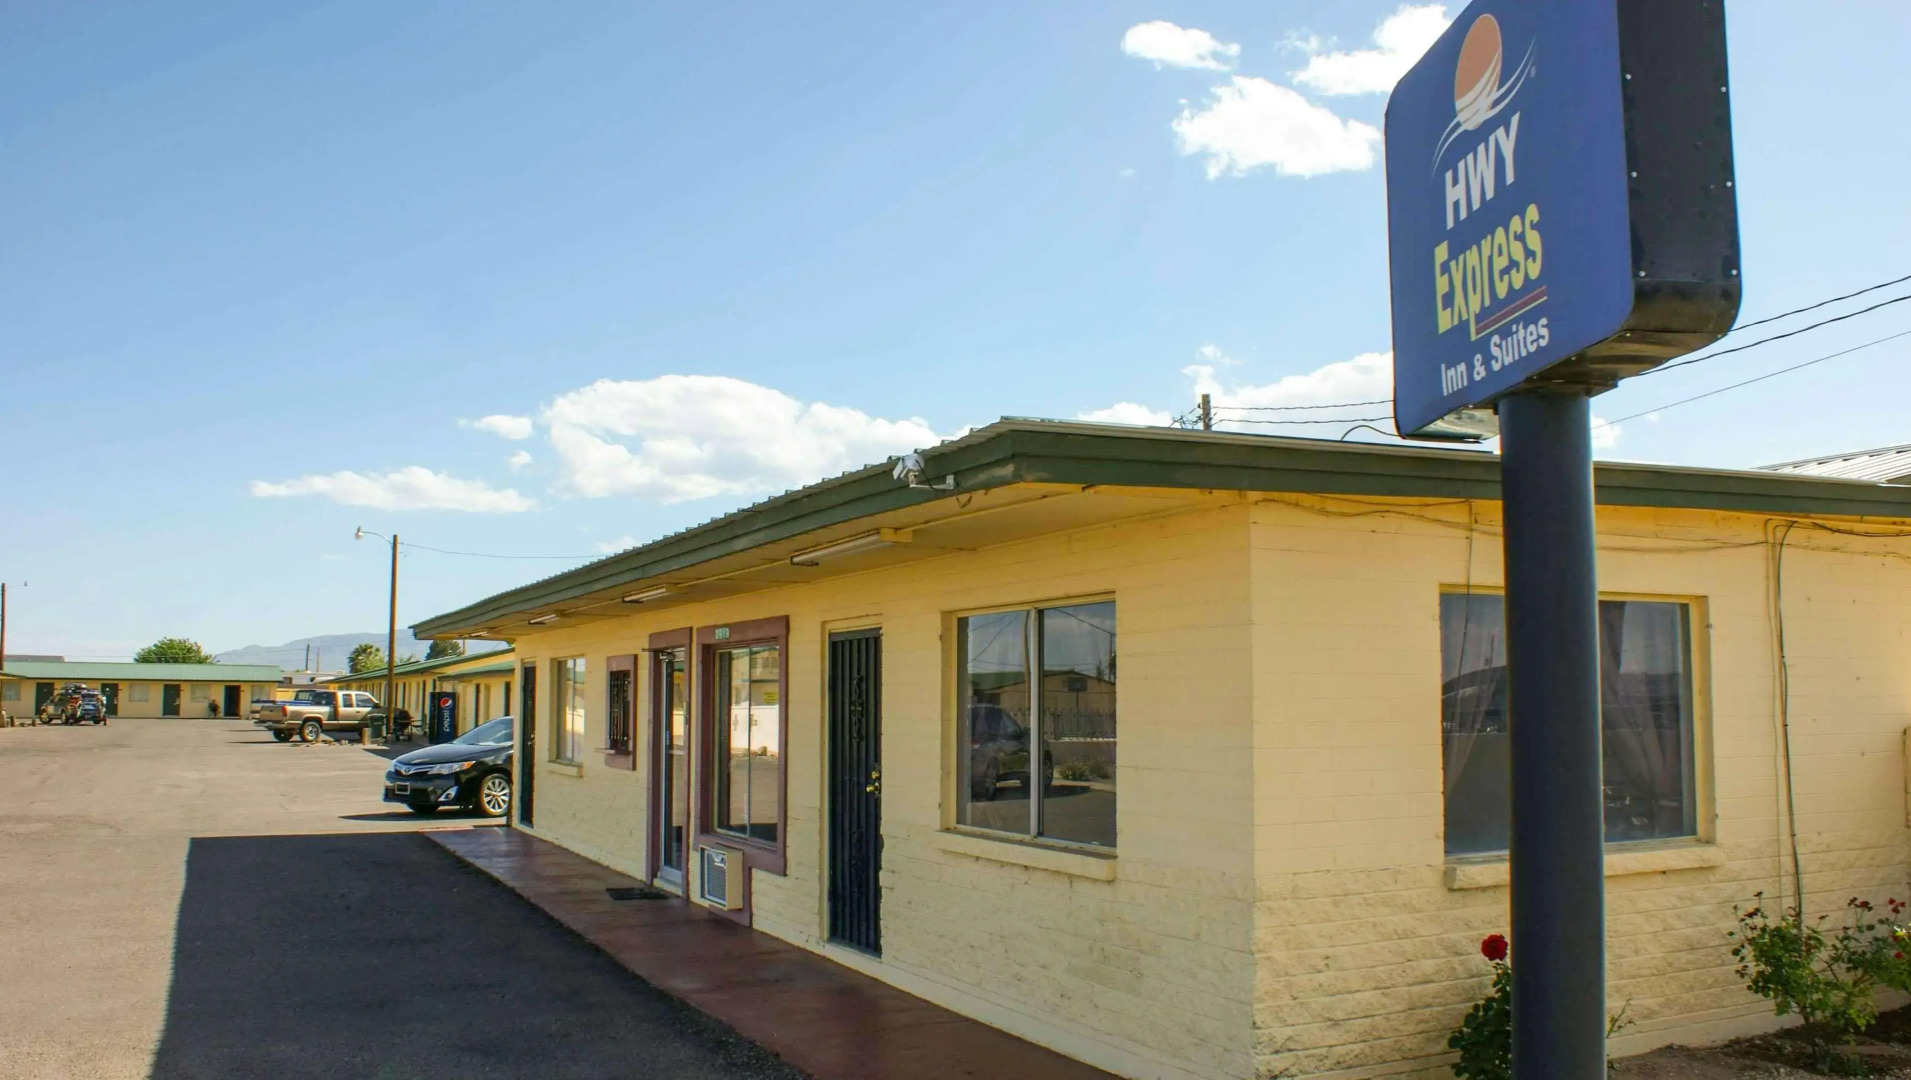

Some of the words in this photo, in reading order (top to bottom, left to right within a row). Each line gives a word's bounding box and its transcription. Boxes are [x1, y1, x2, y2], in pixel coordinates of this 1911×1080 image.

[1445, 111, 1521, 230] HWY
[1434, 203, 1542, 341] Express
[1441, 363, 1468, 397] Inn
[1473, 353, 1487, 381] &
[1490, 317, 1550, 372] Suites
